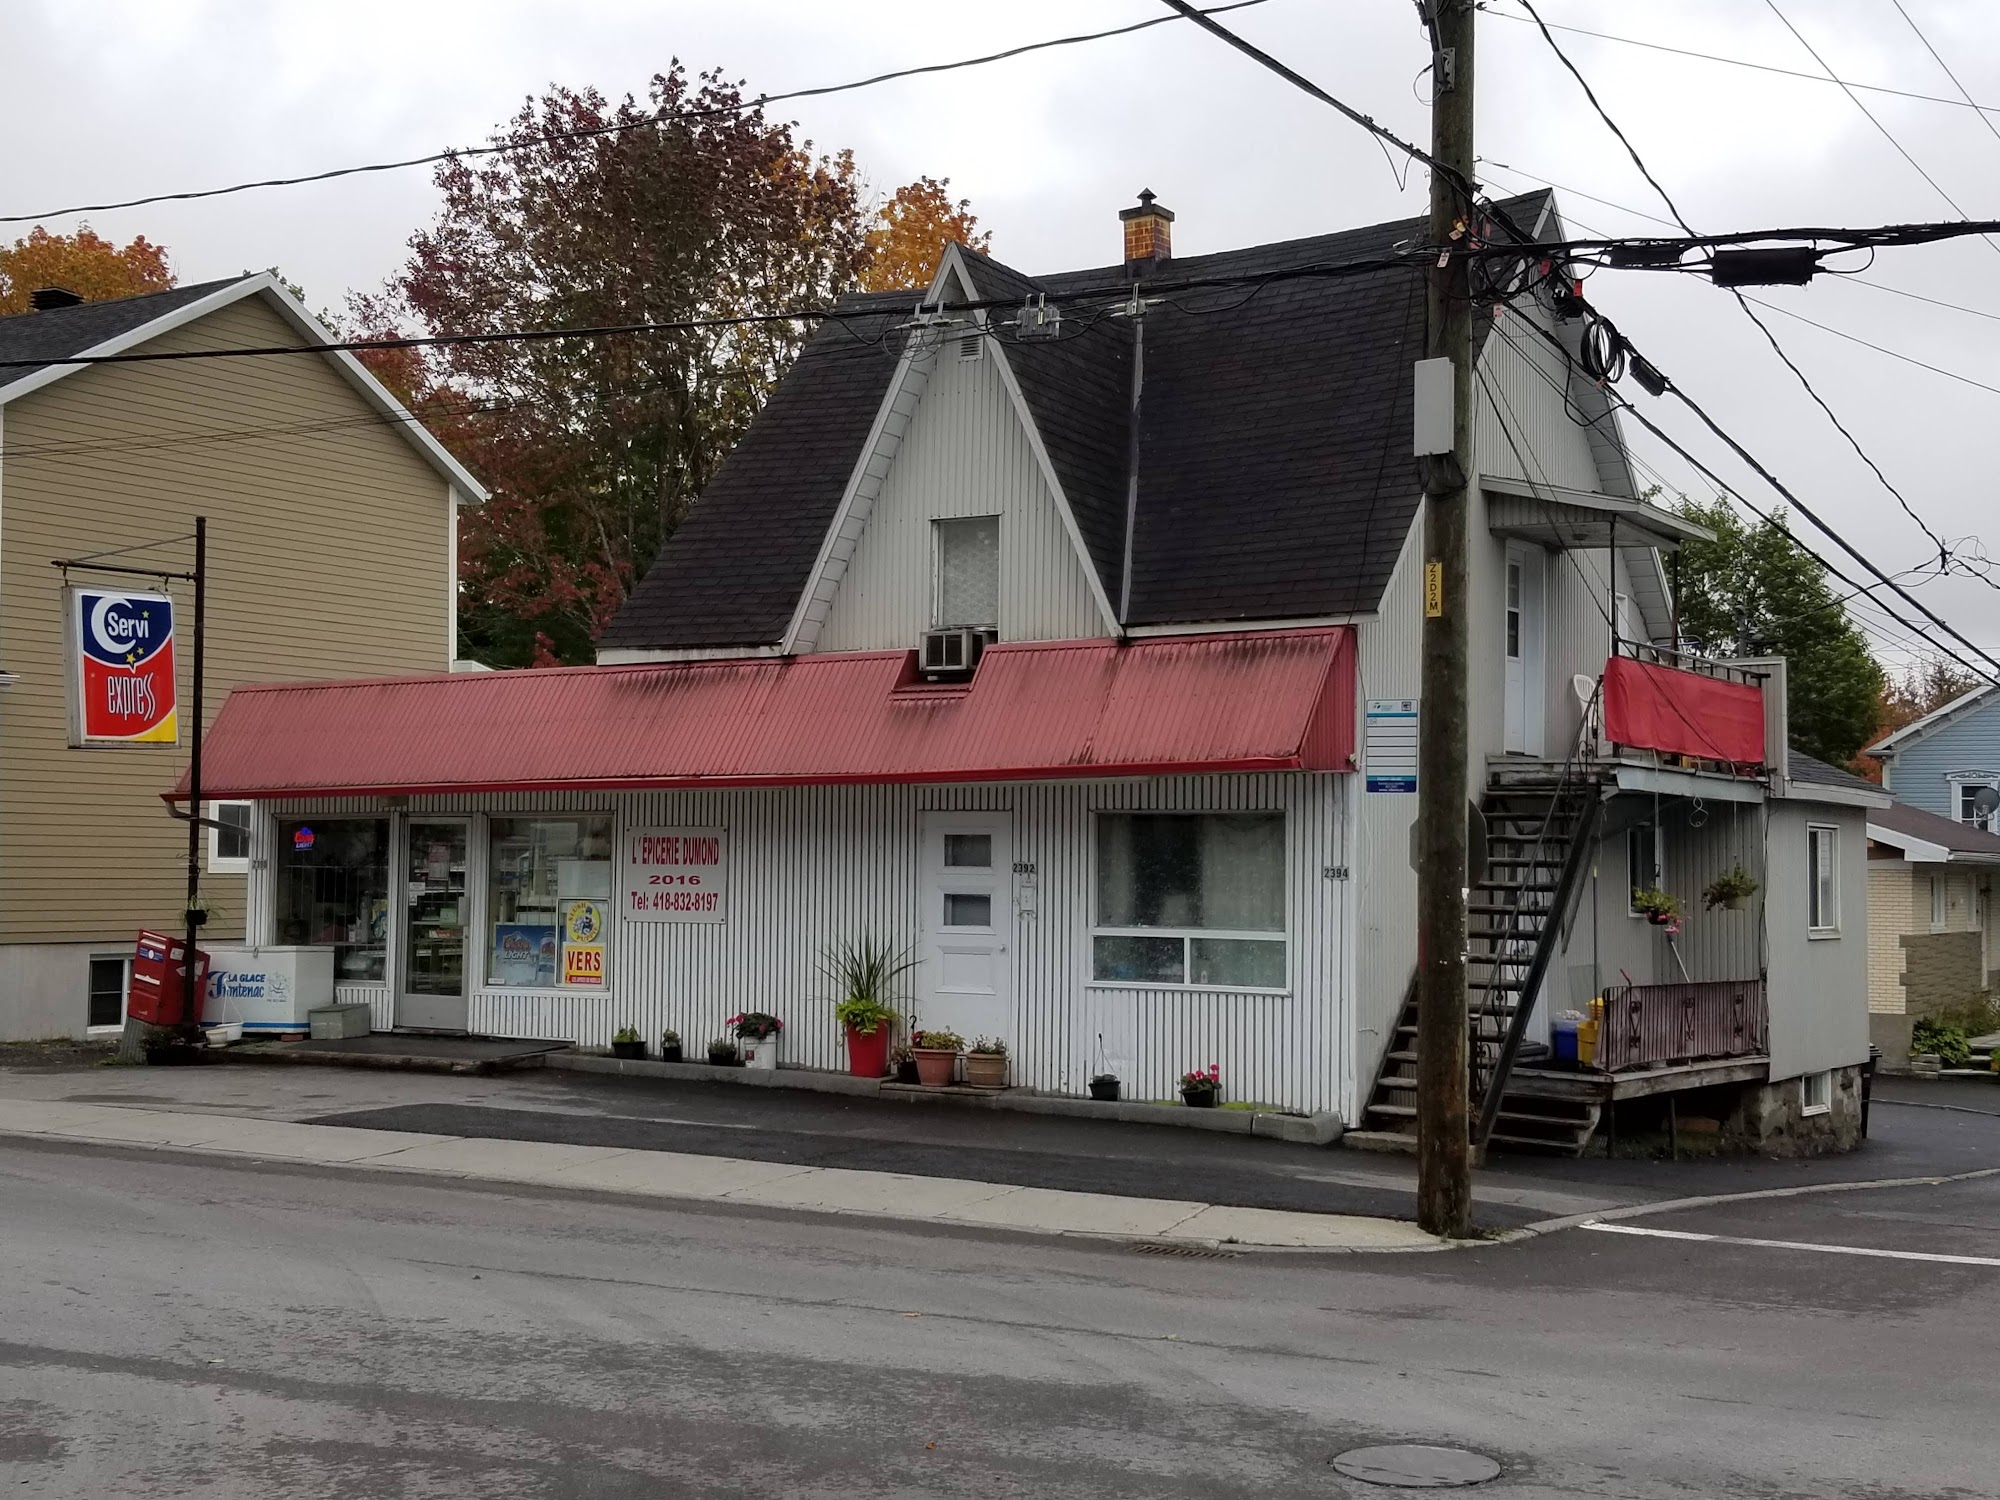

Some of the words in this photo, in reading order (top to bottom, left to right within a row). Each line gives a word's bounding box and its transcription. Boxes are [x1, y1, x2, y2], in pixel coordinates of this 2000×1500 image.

[1429, 563, 1438, 611] Z2D2M
[107, 611, 149, 638] Servi
[107, 672, 156, 722] express
[682, 836, 720, 866] DUMOND
[1013, 863, 1035, 873] 2392
[1324, 868, 1348, 878] 2394
[648, 874, 702, 886] 2016
[631, 891, 649, 911] Tel:
[652, 891, 719, 912] 418-832-8197
[503, 950, 529, 960] LIGHT
[567, 950, 601, 972] VERS
[228, 973, 238, 982] LA
[239, 973, 266, 982] GLACE
